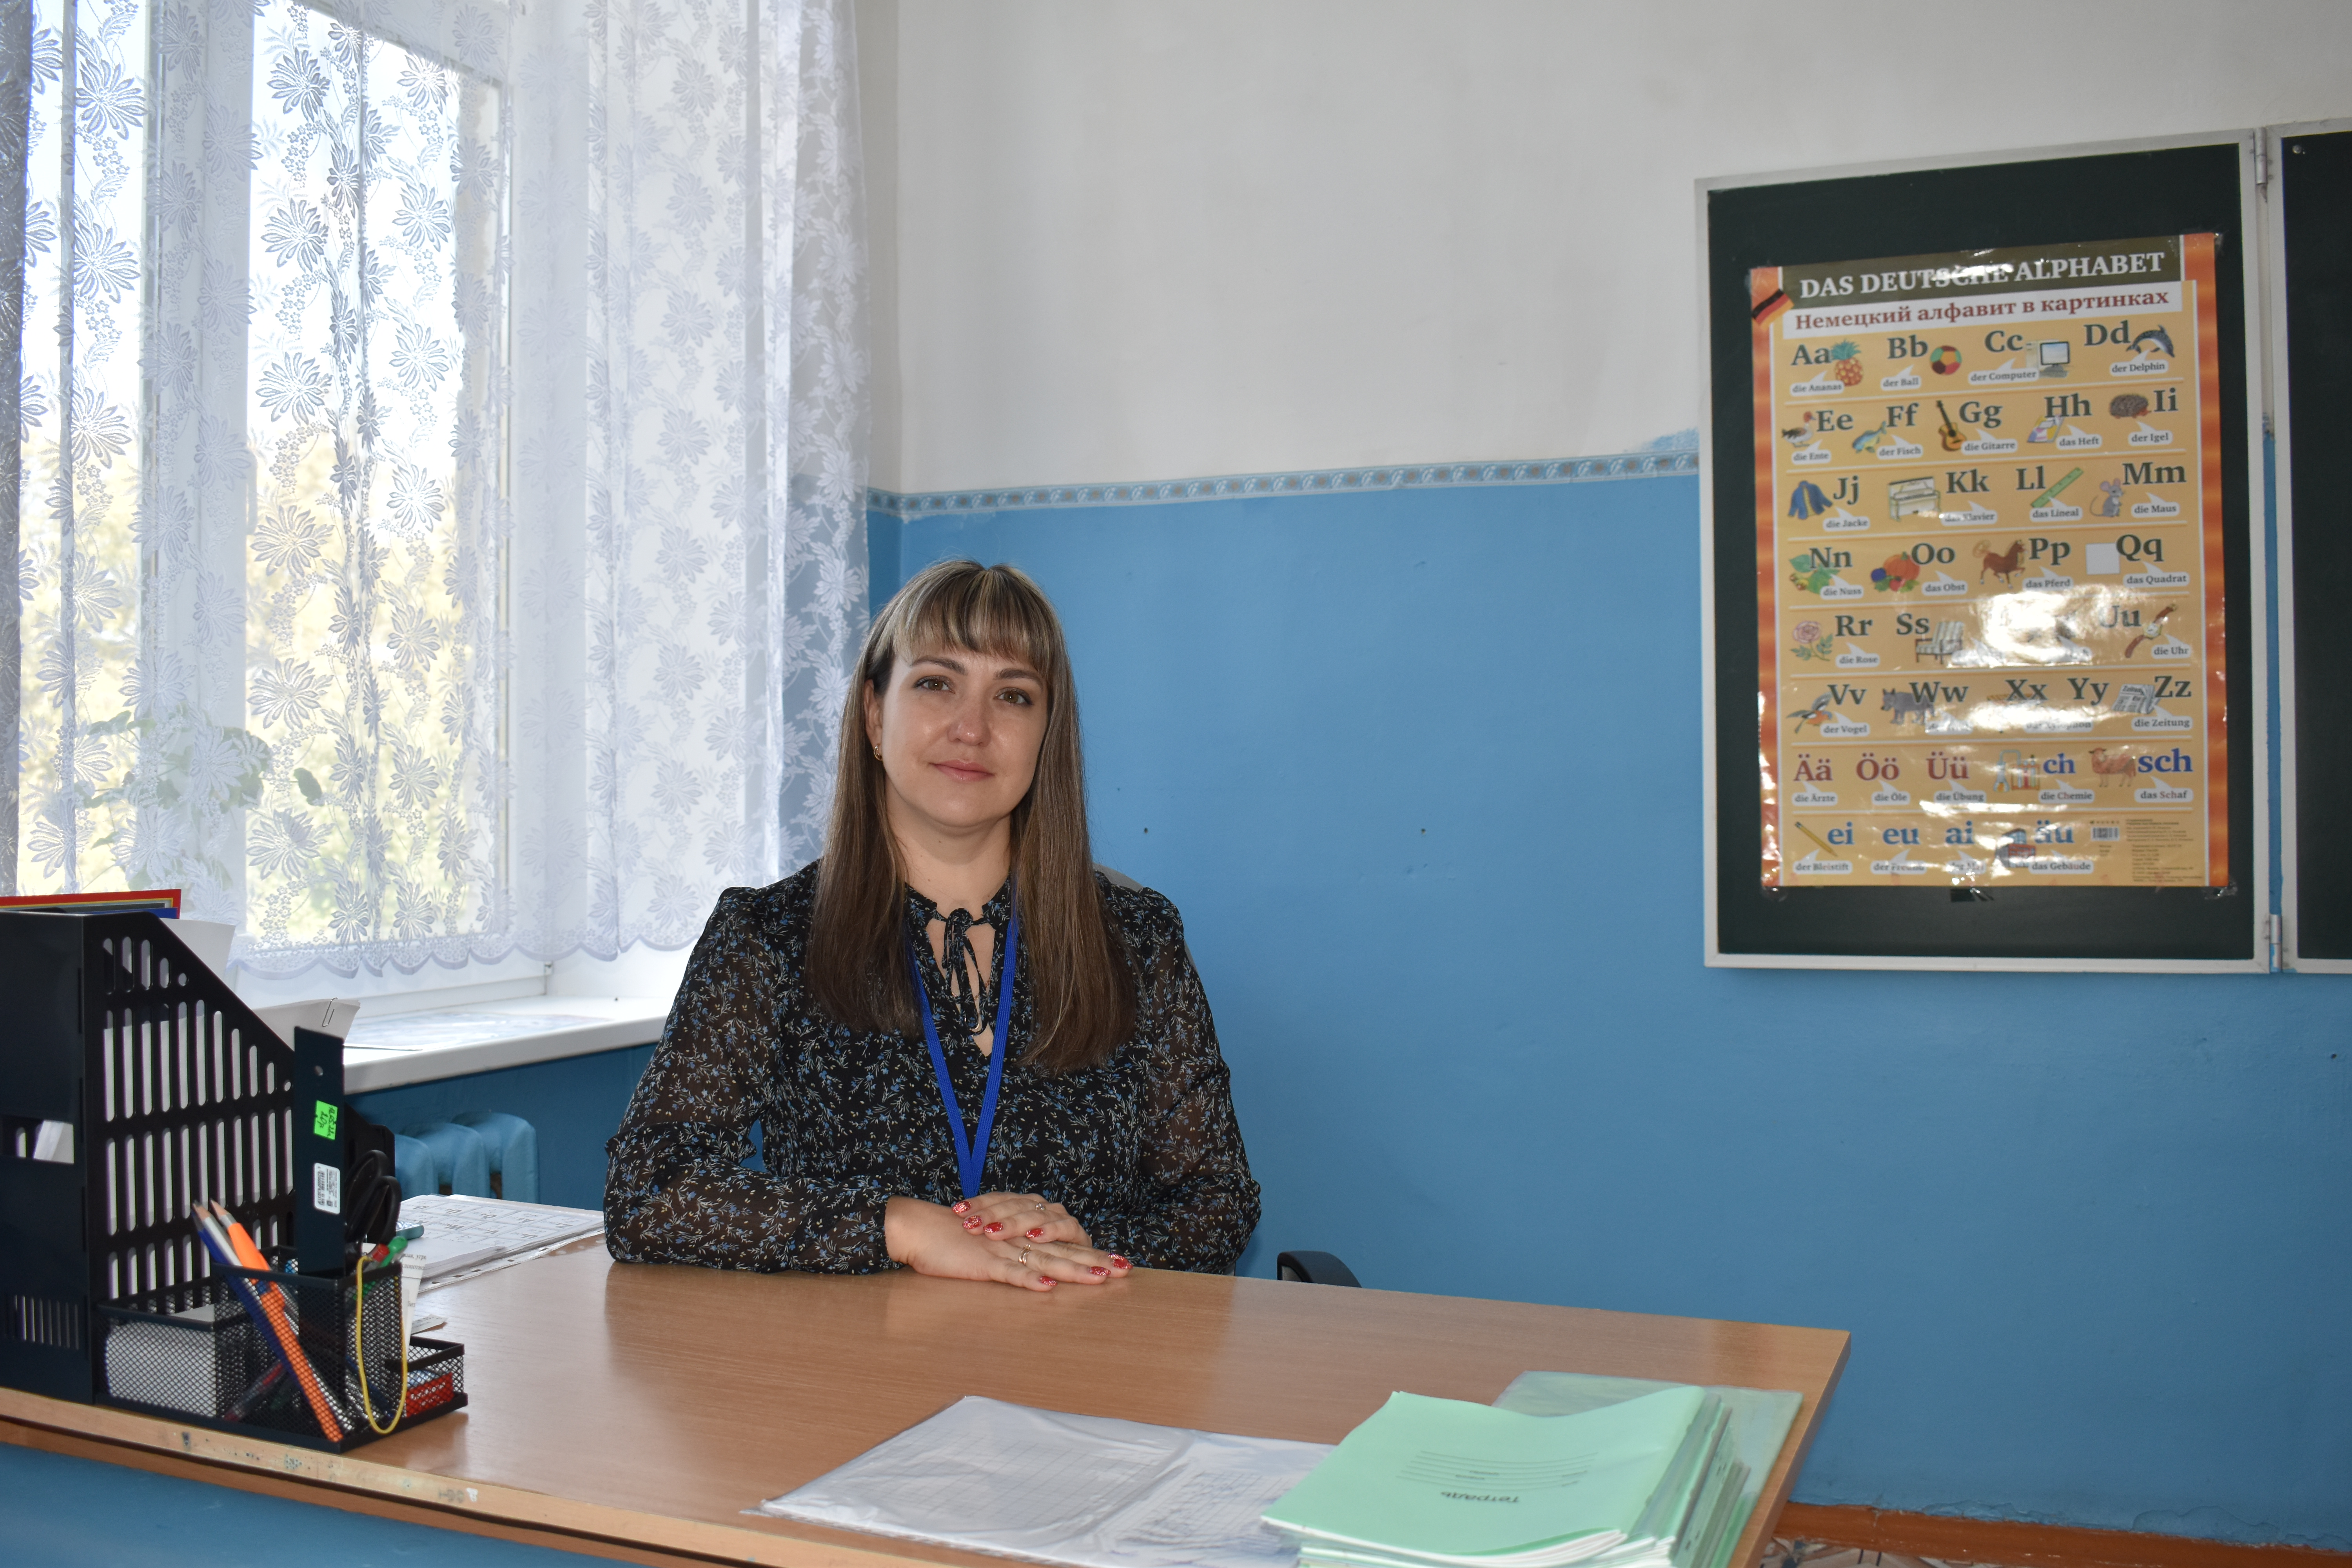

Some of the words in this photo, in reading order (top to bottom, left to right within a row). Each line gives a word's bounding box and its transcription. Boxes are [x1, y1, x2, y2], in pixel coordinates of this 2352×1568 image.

[1799, 276, 1854, 298] DAS
[1860, 265, 2010, 294] DEUTSCHE
[2014, 252, 2165, 282] ALPHABET
[1796, 306, 1911, 330] Немецкий
[1918, 302, 2016, 323] алфавит
[2023, 301, 2034, 313] в
[2042, 291, 2170, 314] картинках
[1984, 330, 2023, 353] Cc
[2083, 319, 2131, 347] Dd
[1791, 343, 1833, 366] Aa
[1887, 334, 1929, 359] Bb
[1971, 372, 1987, 381] der
[1989, 371, 2036, 383] Computer
[2112, 364, 2127, 373] der
[2129, 361, 2165, 374] Delphin
[1792, 384, 1807, 393] die
[1809, 382, 1842, 392] Ananas
[1883, 378, 1899, 387] der
[1901, 377, 1919, 386] Ball
[2044, 393, 2092, 418] Hh
[2154, 387, 2178, 412] Ii
[1816, 410, 1854, 432] Ee
[1886, 402, 1919, 428] Ff
[1959, 401, 2003, 428] Gg
[1964, 442, 1980, 451] die
[1982, 441, 2016, 451] Gitarre
[2059, 437, 2076, 446] das
[2077, 436, 2100, 446] Heft
[2131, 434, 2148, 443] der
[2150, 432, 2169, 443] Igel
[1793, 452, 1807, 461] die
[1808, 451, 1829, 460] Ente
[1879, 447, 1895, 456] der
[1896, 446, 1921, 455] Fisch
[1945, 468, 1990, 494] Kk
[2016, 465, 2046, 490] Ll
[2122, 461, 2187, 486] Mm
[1833, 475, 1860, 505] Jj
[2032, 509, 2049, 518] das
[2051, 508, 2080, 517] Lineal
[2134, 505, 2150, 514] die
[2151, 505, 2177, 514] Maus
[1826, 519, 1841, 528] die
[1842, 519, 1868, 528] Jacke
[1809, 547, 1853, 569] Nn
[1911, 543, 1955, 565] Oo
[2028, 537, 2071, 566] Pp
[2116, 534, 2164, 562] Qq
[1925, 584, 1942, 592] das
[1943, 583, 1965, 592] Obst
[2025, 579, 2043, 588] das
[2044, 578, 2071, 588] Pferd
[2127, 575, 2145, 584] das
[2146, 573, 2187, 584] Quadrat
[1823, 587, 1838, 596] die
[1840, 587, 1862, 595] Nuss
[1835, 615, 1873, 637] Rr
[1896, 613, 1930, 635] Ss
[1839, 656, 1855, 664] die
[1856, 656, 1878, 664] Rose
[2154, 647, 2169, 655] die
[2170, 646, 2189, 655] Uhr
[1828, 684, 1867, 705] Vv
[1909, 682, 1969, 703] Ww
[2005, 679, 2048, 701] Xx
[2067, 677, 2110, 706] Yy
[2154, 675, 2191, 698] Zz
[1823, 725, 1839, 734] der
[1841, 724, 1867, 735] Vogel
[2134, 719, 2150, 728] die
[2152, 718, 2190, 729] Zeitung
[1793, 753, 1833, 781] Ää
[1856, 752, 1900, 780] Öö
[1927, 751, 1969, 780] Üü
[2043, 753, 2075, 774] ch
[2138, 748, 2193, 773] sch
[1795, 794, 1809, 803] die
[1811, 792, 1835, 803] Ärzte
[1874, 793, 1890, 802] die
[1891, 791, 1907, 802] Öle
[1936, 792, 1951, 801] die
[1953, 791, 1985, 803] Übung
[2041, 791, 2056, 800] die
[2057, 791, 2093, 800] Chemie
[2141, 790, 2157, 799] das
[2159, 789, 2187, 799] Schaf
[1827, 822, 1855, 845] ei
[1883, 828, 1920, 846] eu
[1945, 820, 1974, 845] ai
[1795, 862, 1811, 871] der
[1813, 862, 1849, 871] Bleistift
[1873, 862, 1889, 871] der
[2031, 862, 2049, 871] das
[2050, 861, 2091, 871] Gebäude
[1440, 1491, 1519, 1503] Тетрадь
